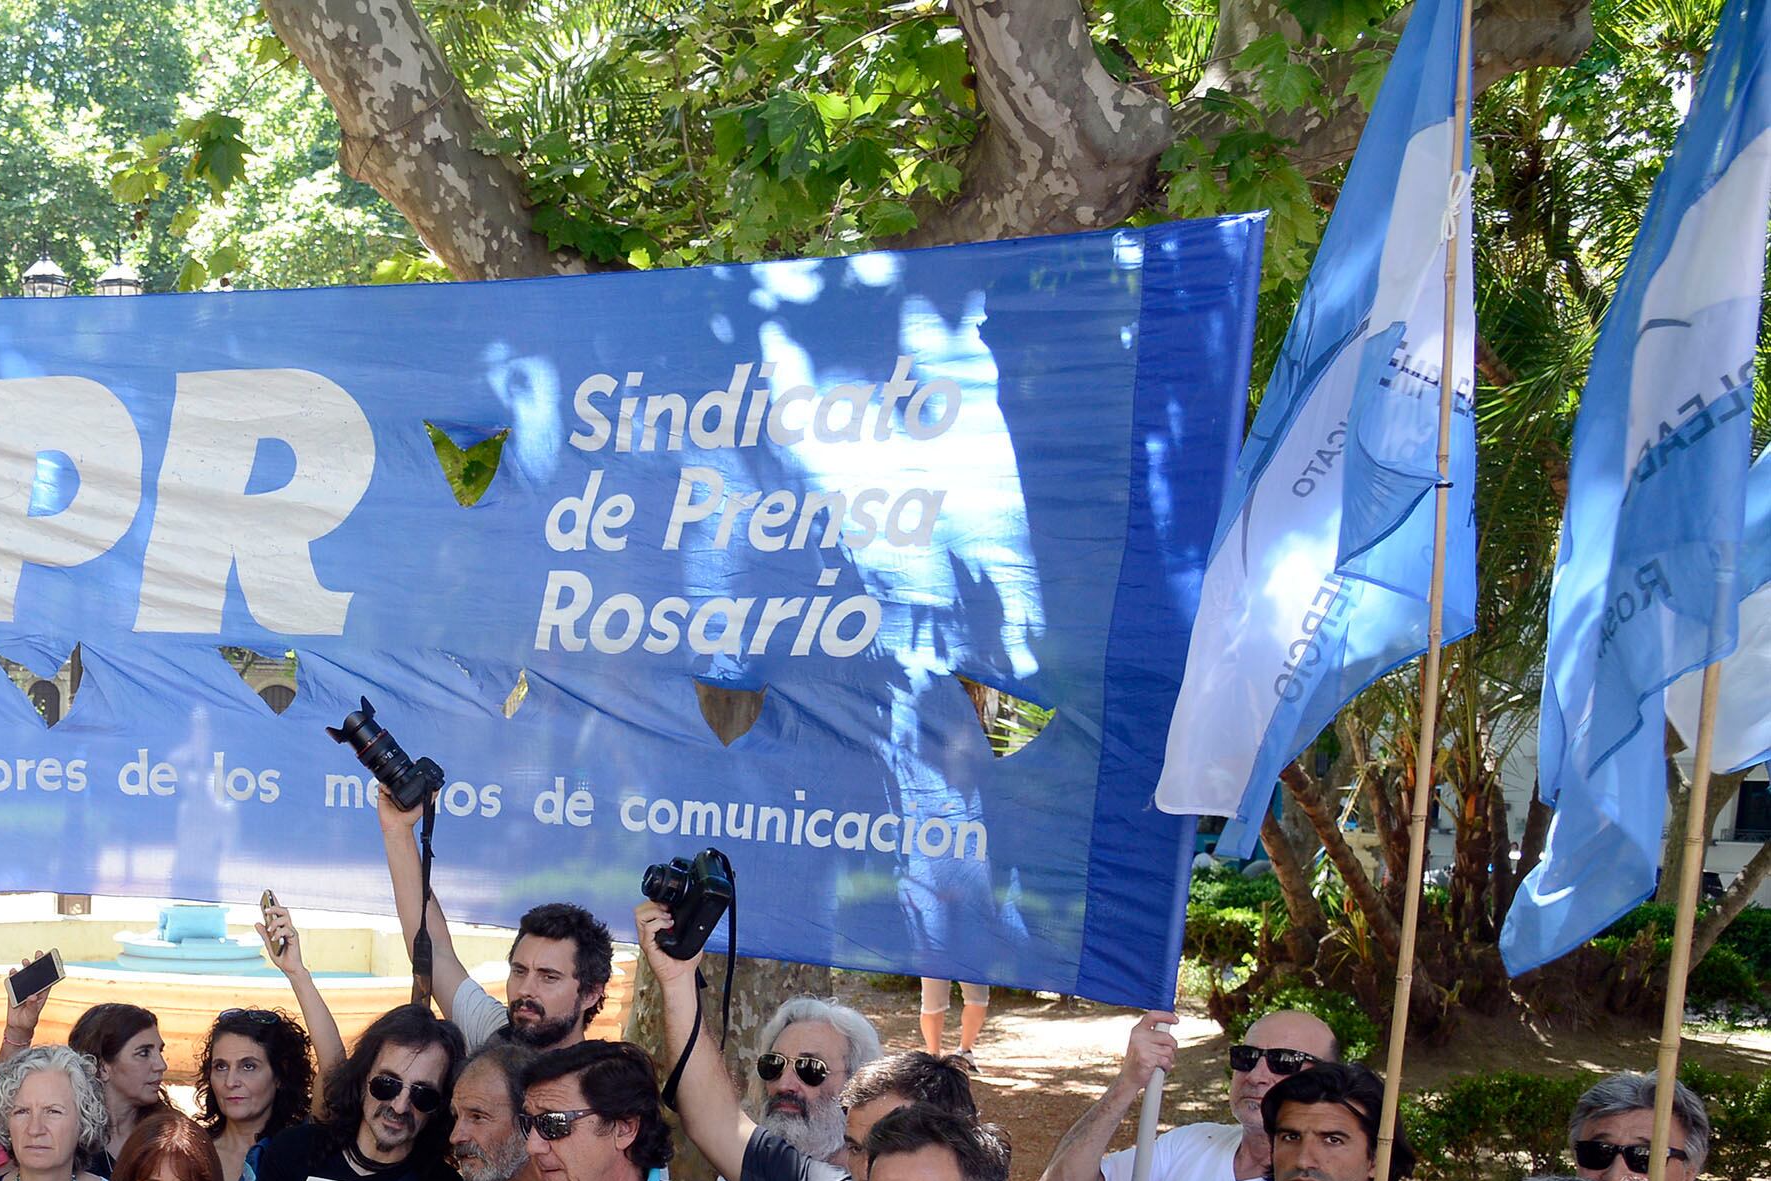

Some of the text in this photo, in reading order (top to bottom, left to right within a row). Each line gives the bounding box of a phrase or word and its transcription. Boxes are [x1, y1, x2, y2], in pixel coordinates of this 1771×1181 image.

[568, 355, 962, 453] Sindicato
[545, 466, 948, 553] de Prensa
[533, 567, 883, 658] Rosario
[117, 749, 178, 796] de
[214, 751, 280, 803] los
[325, 773, 502, 819] meos
[534, 776, 595, 827] de
[620, 789, 989, 862] comunicación
